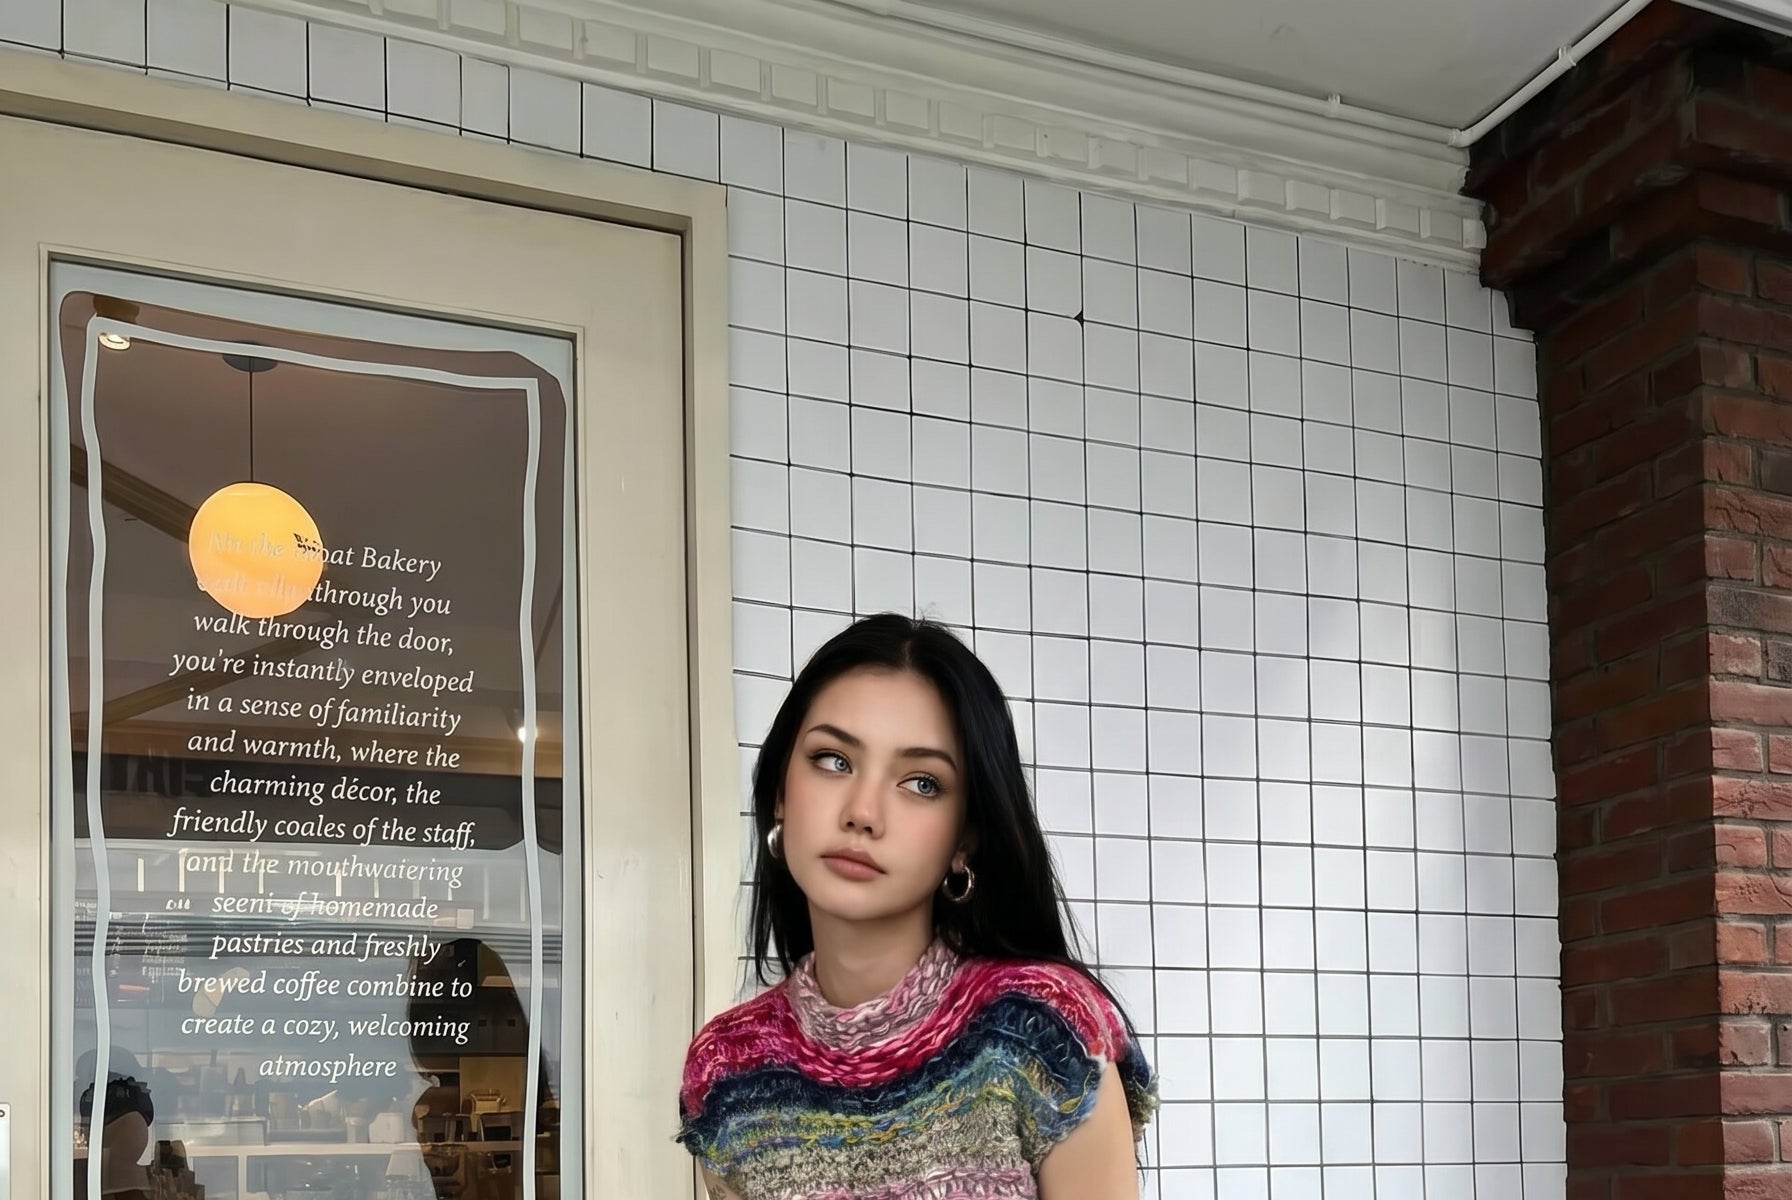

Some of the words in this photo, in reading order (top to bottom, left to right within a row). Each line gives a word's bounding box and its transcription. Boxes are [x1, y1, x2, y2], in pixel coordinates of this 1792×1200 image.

[361, 546, 442, 582] Bakery
[407, 596, 451, 618] you
[194, 610, 250, 636] walk
[258, 615, 349, 649] through
[356, 624, 391, 647] the
[399, 627, 454, 656] door,
[169, 650, 245, 676] you're
[253, 653, 355, 690] instantly
[362, 666, 475, 697] enveloped
[187, 687, 209, 711] in
[218, 696, 232, 713] a
[240, 698, 301, 718] sense
[309, 698, 335, 727] of
[332, 699, 462, 737] familiarity
[188, 730, 234, 752] and
[243, 738, 341, 763] warmth,
[351, 740, 418, 766] where
[425, 745, 460, 768] the
[210, 770, 325, 806] charming
[332, 777, 397, 805] décor,
[406, 781, 441, 805] the
[167, 806, 268, 842] friendly
[274, 815, 346, 838] coales
[353, 817, 379, 846] of
[382, 819, 417, 842] the
[423, 821, 476, 850] staff,
[186, 848, 234, 873] and
[243, 849, 280, 874] the
[281, 891, 309, 921] of
[312, 893, 439, 919] homemade
[209, 931, 304, 959] pastries
[311, 933, 357, 956] and
[359, 933, 441, 965] freshly
[178, 968, 266, 994] brewed
[273, 970, 340, 1001] coffee
[347, 974, 444, 998] combine
[451, 979, 473, 998] to
[181, 1014, 254, 1035] create
[261, 1018, 276, 1035] a
[283, 1018, 340, 1043] cozy,
[348, 1015, 471, 1045] welcoming
[259, 1053, 398, 1084] atmosphere
